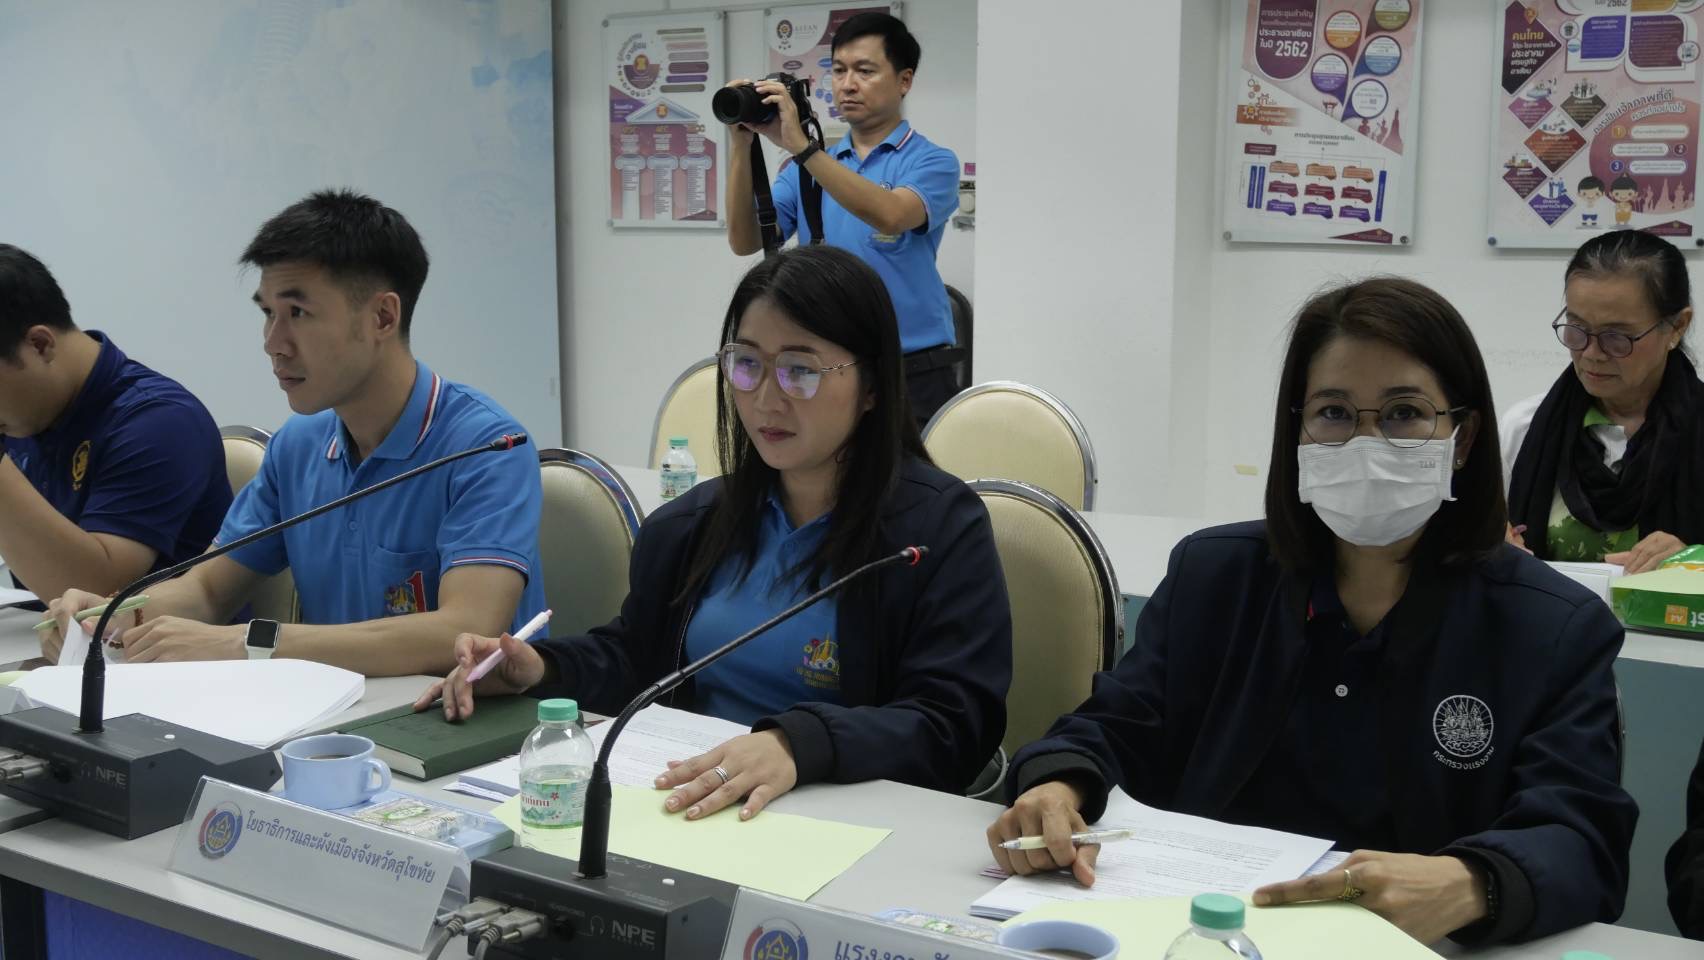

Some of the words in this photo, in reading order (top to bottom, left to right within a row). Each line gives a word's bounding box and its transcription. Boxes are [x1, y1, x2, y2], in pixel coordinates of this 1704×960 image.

[1512, 28, 1545, 41] คนไทย
[1275, 40, 1309, 57] 2562
[1432, 745, 1495, 770] กระทรวงแรงงาน
[95, 765, 127, 787] NPE
[245, 810, 436, 884] โยธาธิการและผังเมืองจังหวัดสุโขทัย
[611, 919, 657, 946] NPE
